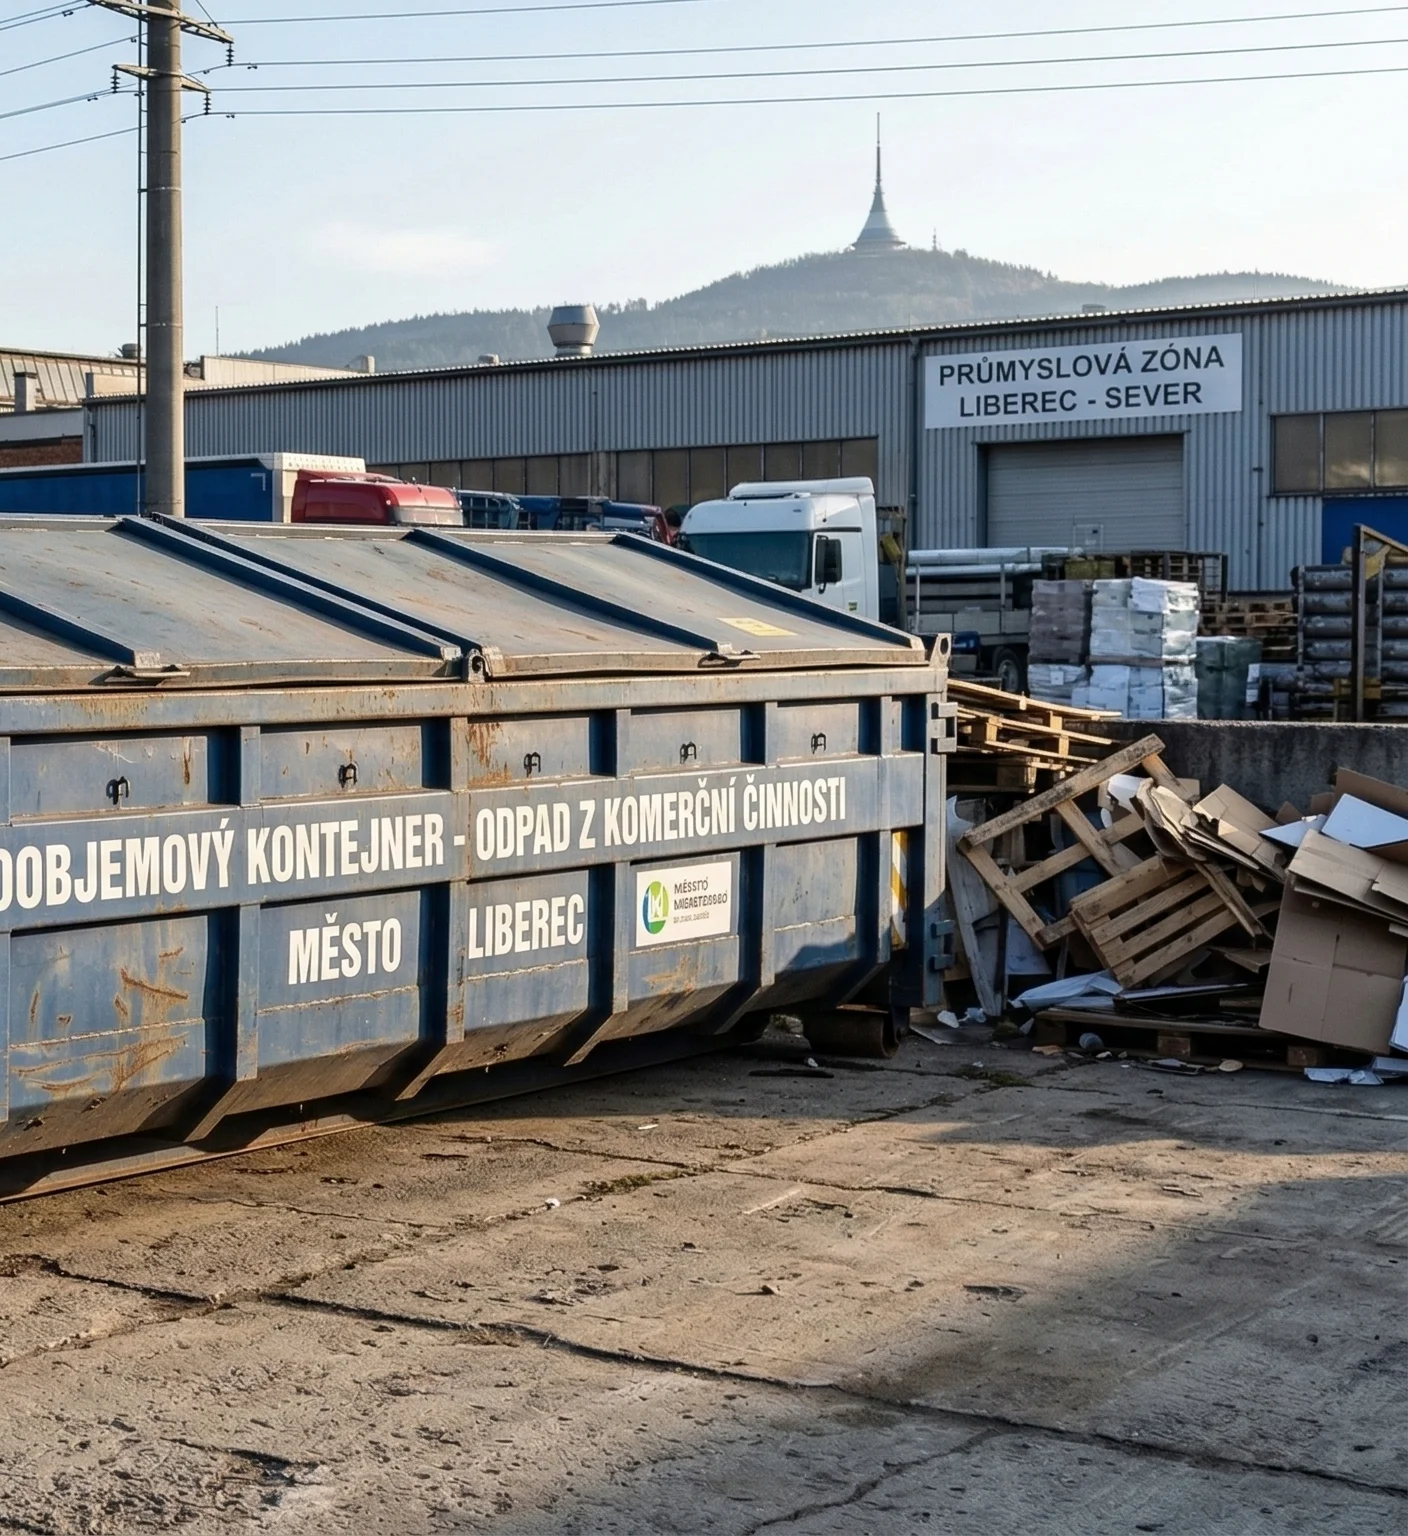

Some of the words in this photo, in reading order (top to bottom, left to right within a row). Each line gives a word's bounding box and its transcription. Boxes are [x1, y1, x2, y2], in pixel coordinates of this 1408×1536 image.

[939, 346, 1133, 387] PRŮMYSLOVÁ
[1140, 342, 1225, 373] ZÓNA
[959, 389, 1078, 418] LIBEREC
[1104, 381, 1203, 409] SEVER
[247, 812, 445, 886] KONTEJNER
[453, 834, 466, 847] -
[476, 801, 571, 862] ODPAD
[578, 799, 597, 850] Z
[604, 776, 736, 848] KOMERČNÍ
[742, 773, 847, 832] ČINNOSTI
[288, 912, 403, 986] MĚSTO
[467, 892, 585, 960] LIBEREC
